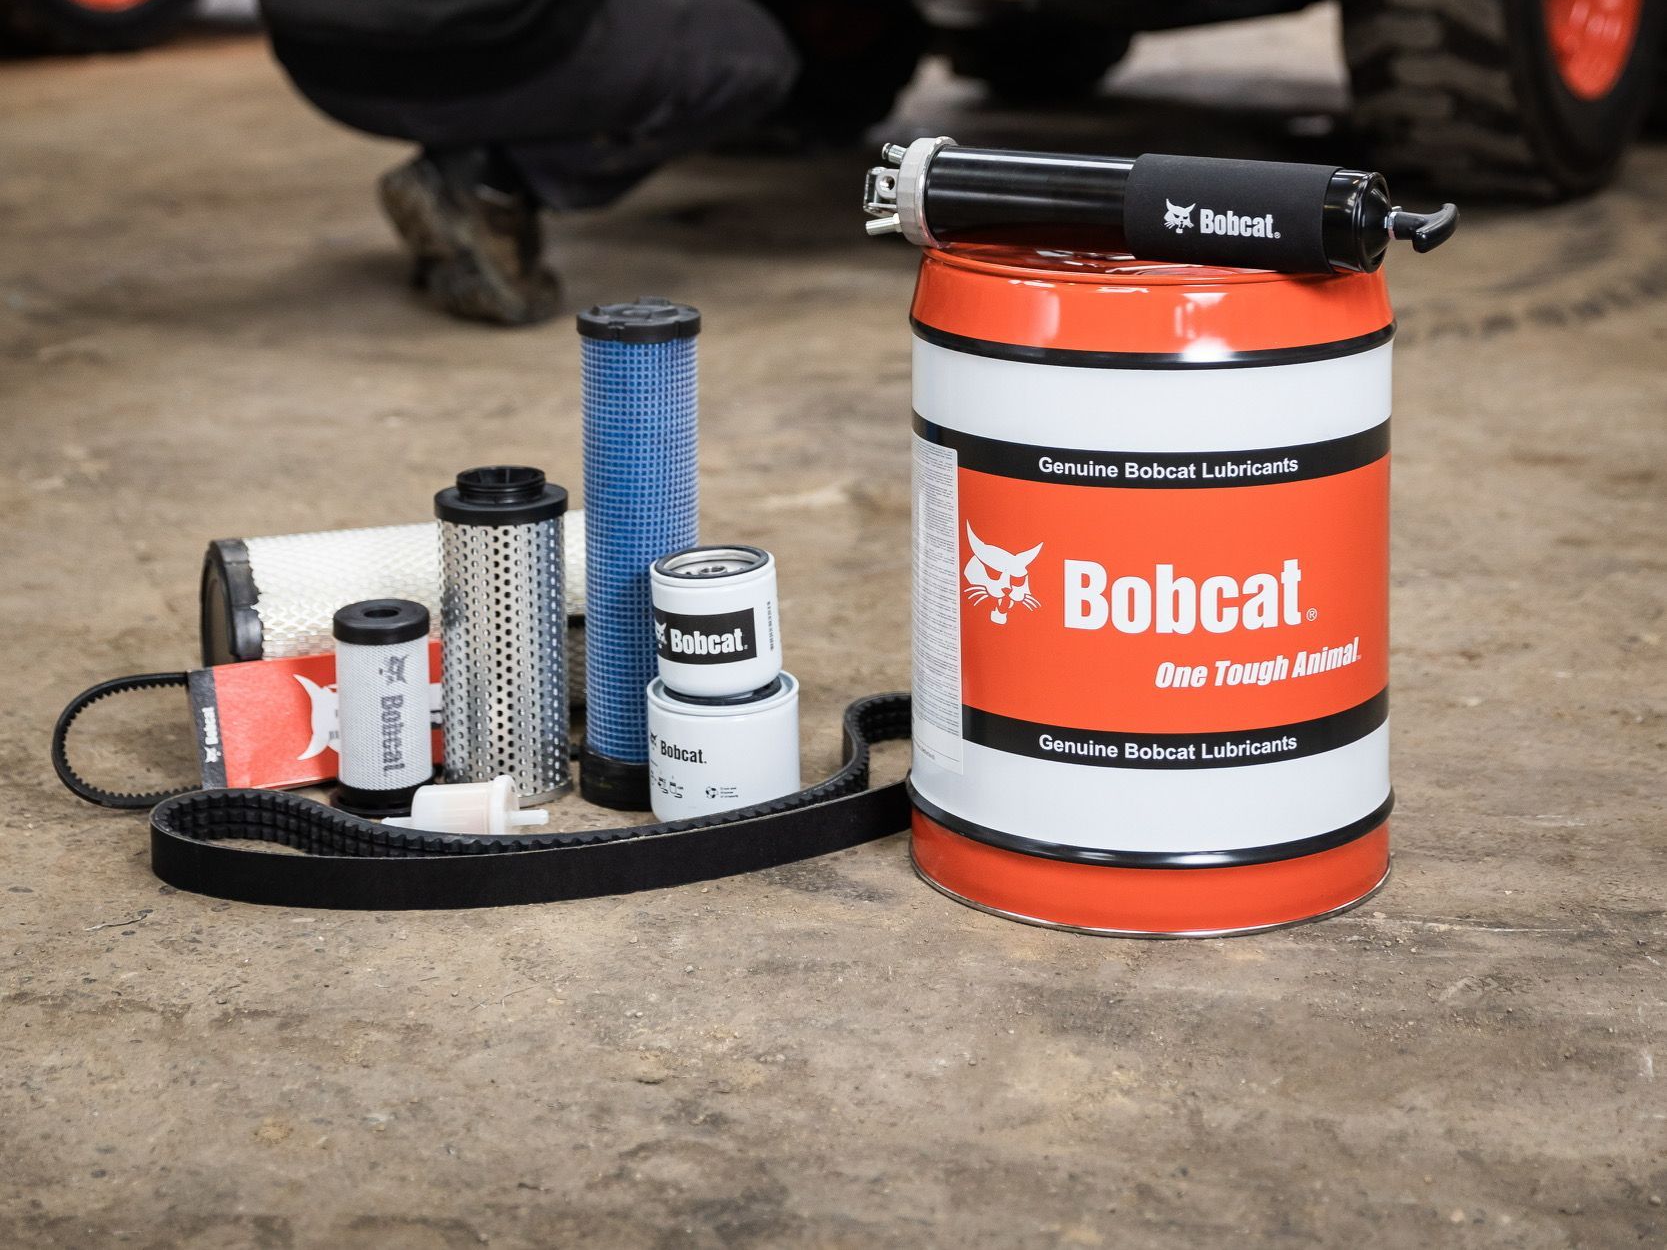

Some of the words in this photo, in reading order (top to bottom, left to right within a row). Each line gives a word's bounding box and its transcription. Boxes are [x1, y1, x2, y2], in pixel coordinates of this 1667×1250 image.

[1038, 456, 1119, 478] Genuine
[1124, 461, 1196, 479] Bobcat
[1201, 456, 1299, 479] Lubricants
[1155, 661, 1208, 688] One
[1214, 655, 1290, 686] Tough
[1291, 636, 1360, 678] Animal
[1038, 734, 1119, 758] Genuine
[1124, 742, 1196, 760] Bobcat
[1201, 735, 1298, 759] Lubricants
